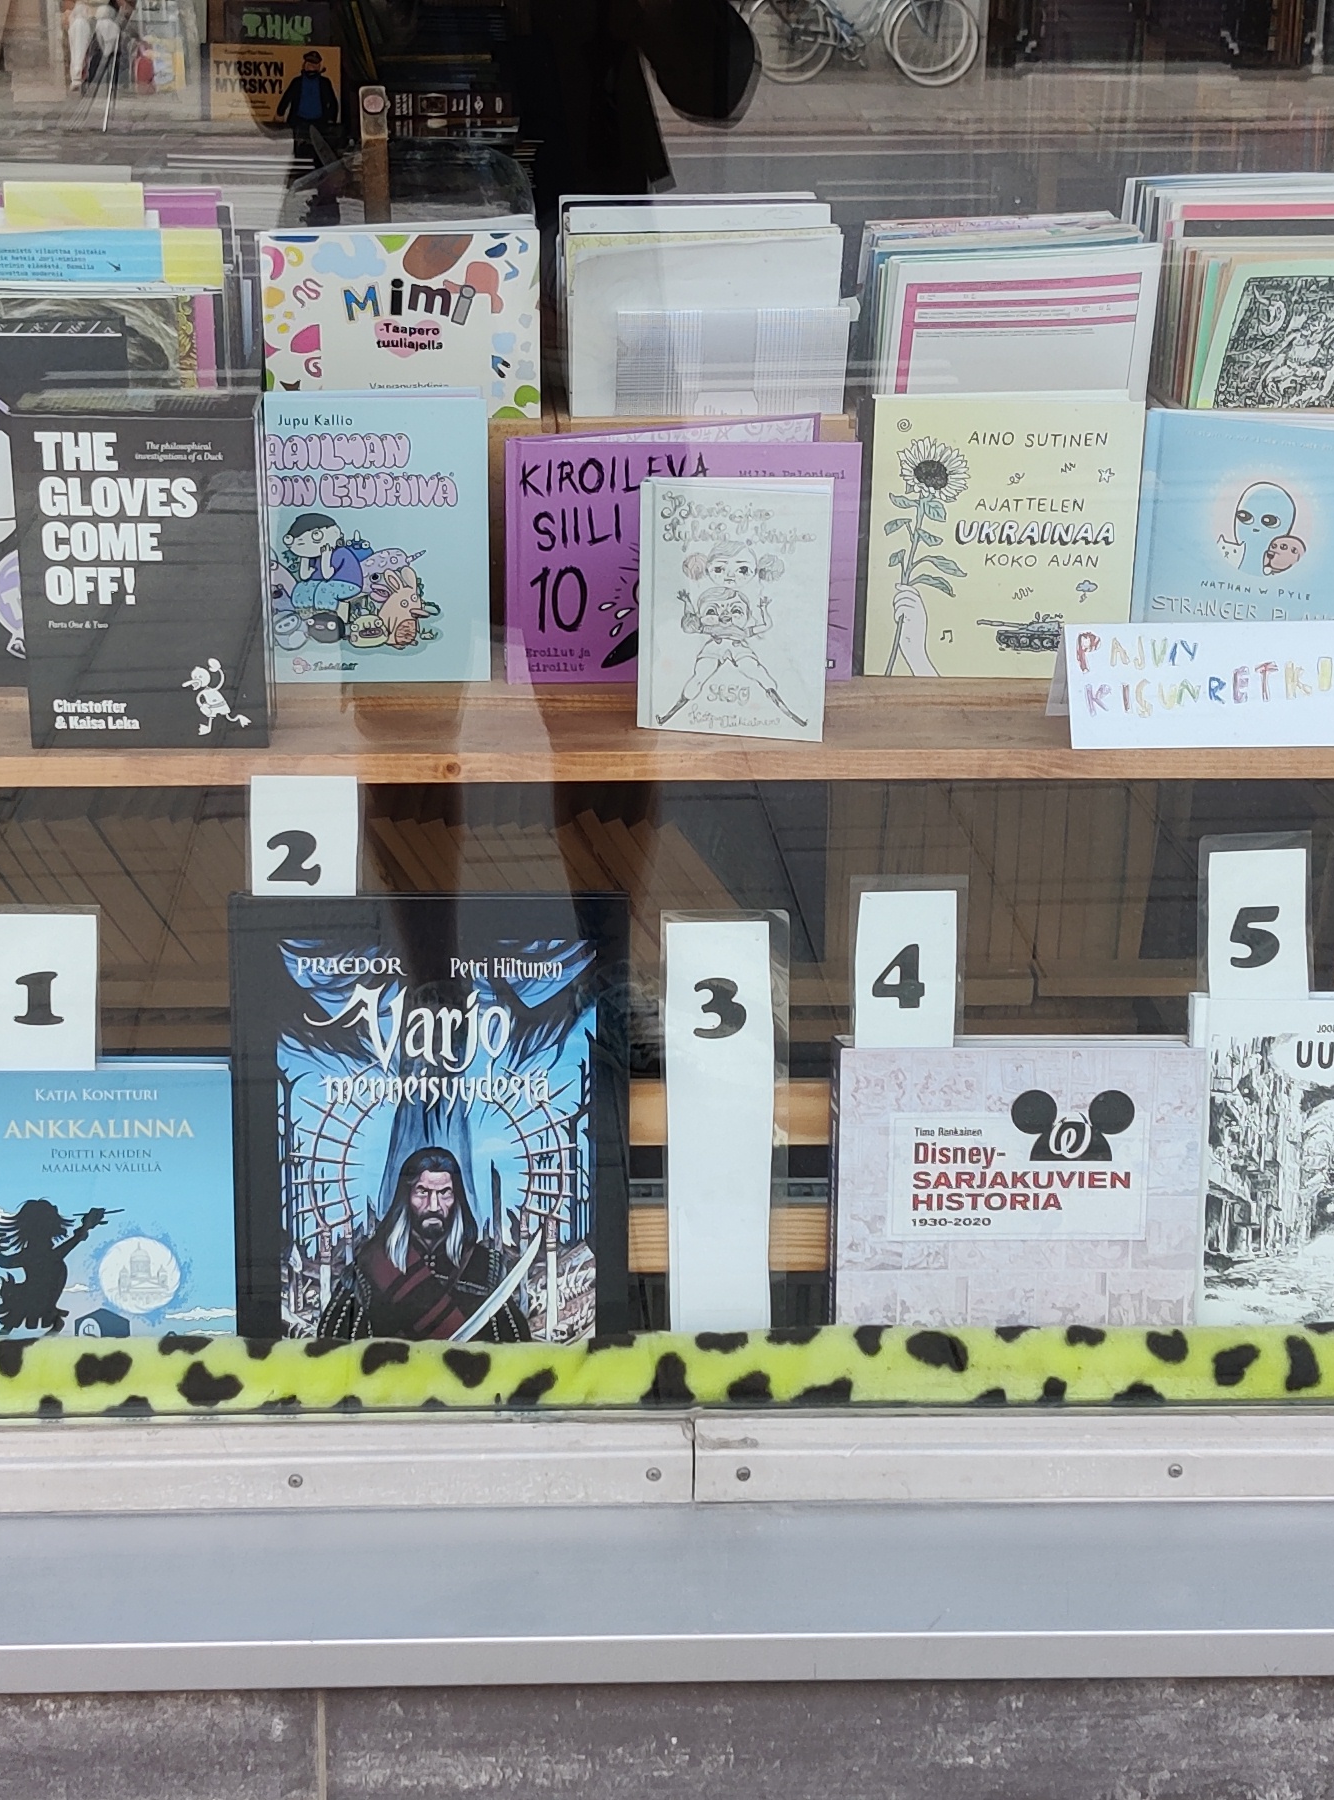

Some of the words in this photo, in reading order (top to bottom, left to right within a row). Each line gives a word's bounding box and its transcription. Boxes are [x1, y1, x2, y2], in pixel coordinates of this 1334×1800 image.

[214, 60, 284, 77] TYRSKYN
[216, 78, 283, 94] MYRSKY!
[341, 278, 475, 326] Mimi
[376, 338, 443, 352] tuuliajolla
[278, 415, 309, 429] Jupu
[314, 415, 353, 426] Kallio
[34, 431, 119, 471] THE
[146, 441, 159, 451] The
[161, 441, 212, 453] philosophical
[968, 431, 1014, 446] AINO
[1024, 432, 1108, 448] SUTINEN
[135, 452, 187, 462] investigations
[188, 452, 196, 463] of
[204, 452, 223, 461] Duck
[267, 433, 411, 471] AAILMAN
[519, 452, 709, 497] KIROILEVA
[39, 476, 198, 518] GLOVES
[975, 497, 1085, 513] AJATTELEN
[533, 503, 621, 551] SIILI
[955, 519, 1115, 546] UKRAINAA
[41, 521, 163, 562] COME
[984, 553, 1037, 568] KOKO
[1047, 554, 1099, 568] AJAN
[45, 565, 136, 605] OFF!
[1201, 580, 1251, 594] NATHAN
[1278, 588, 1311, 601] PYLE
[530, 565, 588, 633] 10
[1152, 595, 1257, 620] STRANGER
[48, 621, 67, 629] Parts
[68, 621, 83, 629] One
[93, 621, 108, 629] Two
[525, 648, 575, 659] Eroilut
[580, 648, 591, 660] ja
[1076, 631, 1198, 674] PAJUN
[528, 662, 584, 673] kiroilut
[53, 699, 127, 714] Christoffer
[55, 716, 68, 730] &
[69, 716, 106, 730] Kaisa
[108, 716, 140, 730] Leka
[266, 829, 322, 886] 2
[1230, 905, 1280, 968] 5
[296, 956, 408, 977] PRAEDOR
[450, 957, 488, 979] Petri
[493, 957, 563, 981] Hiltunen
[872, 943, 925, 1009] 4
[13, 971, 65, 1026] 1
[693, 977, 747, 1039] 3
[303, 983, 510, 1074] Varjo
[317, 1061, 551, 1116] menneisyydestä
[3, 1118, 195, 1139] ANKKALINNA
[915, 1127, 935, 1137] Timo
[42, 1163, 111, 1172] MAAILMAN
[114, 1160, 162, 1172] VÄLILLÄ
[914, 1142, 1006, 1170] Disney-
[912, 1170, 1131, 1189] SARJAKUVIEN
[912, 1192, 1063, 1211] HISTORIA
[911, 1217, 992, 1227] 1930-2020
